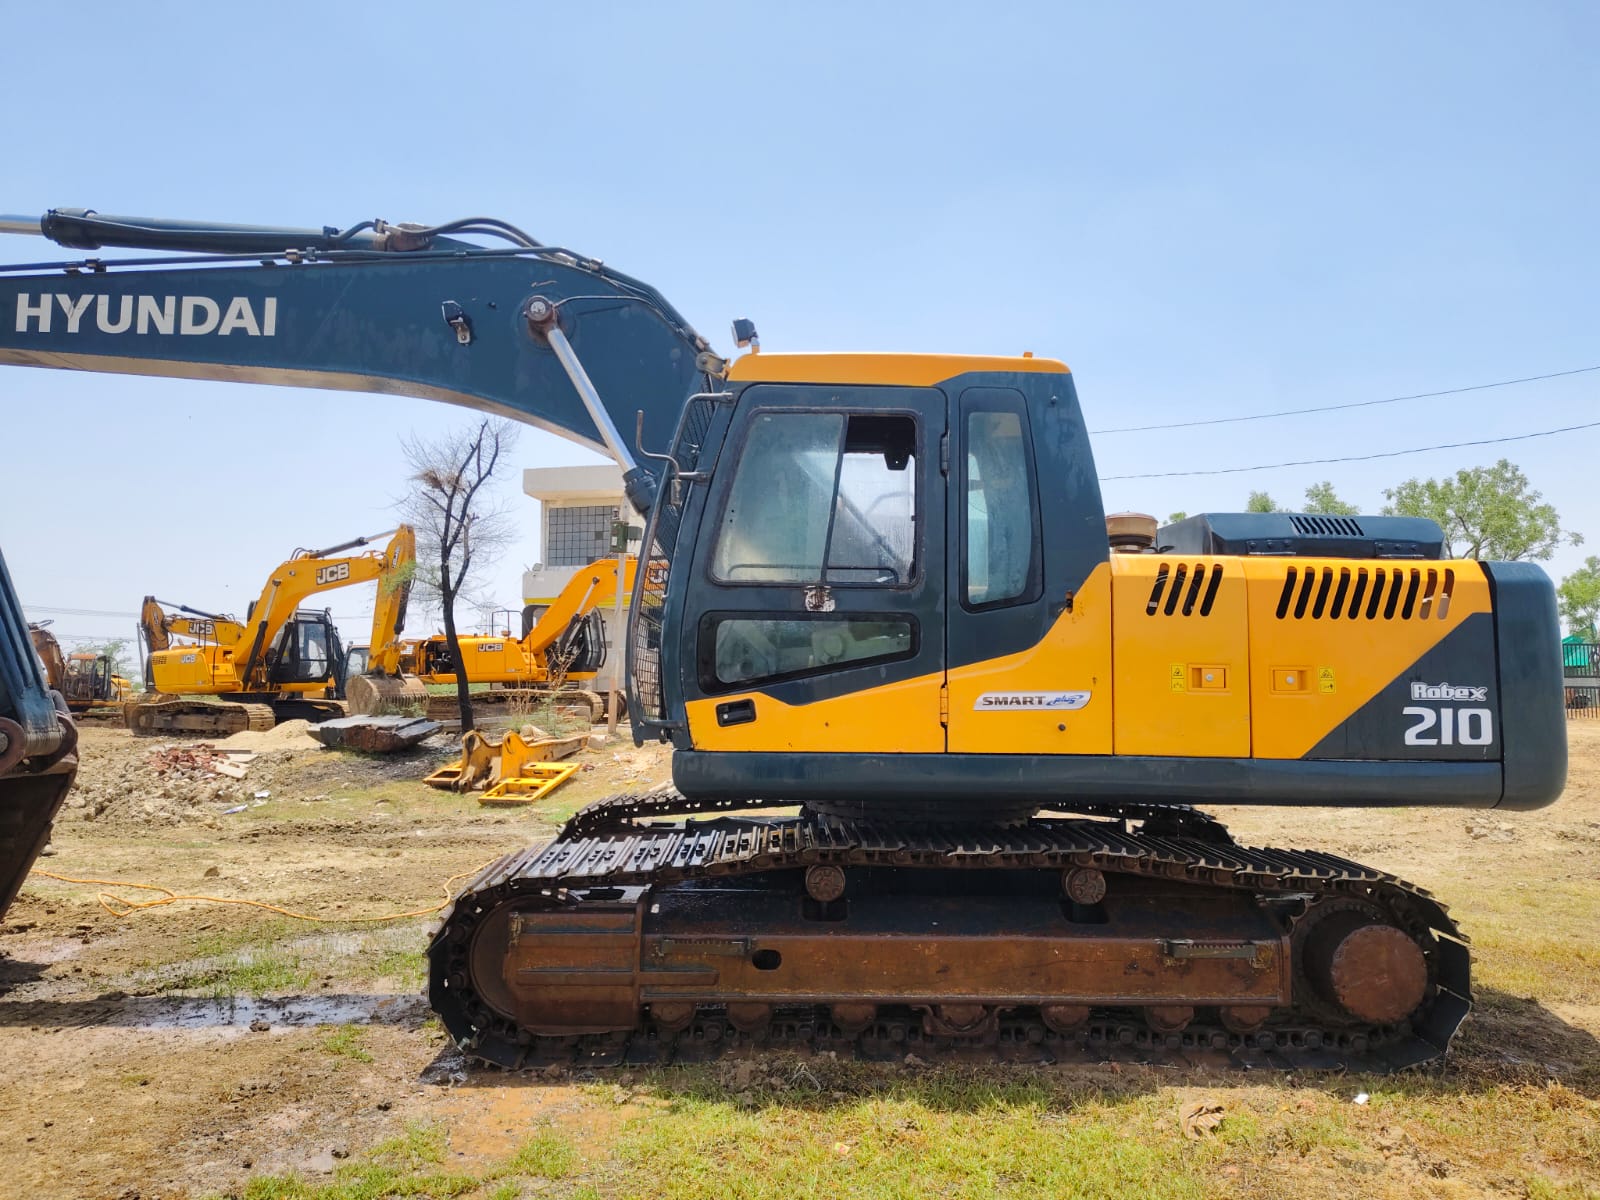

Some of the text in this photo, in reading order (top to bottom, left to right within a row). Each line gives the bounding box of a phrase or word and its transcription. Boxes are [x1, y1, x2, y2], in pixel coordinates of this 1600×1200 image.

[15, 293, 278, 337] HYUNDAI
[317, 562, 350, 585] JCB
[189, 622, 214, 634] JCB
[478, 643, 503, 652] JCB
[181, 654, 196, 664] JCB
[1411, 682, 1488, 701] Robex
[982, 694, 1083, 706] SMART plus
[1402, 707, 1493, 746] 210
